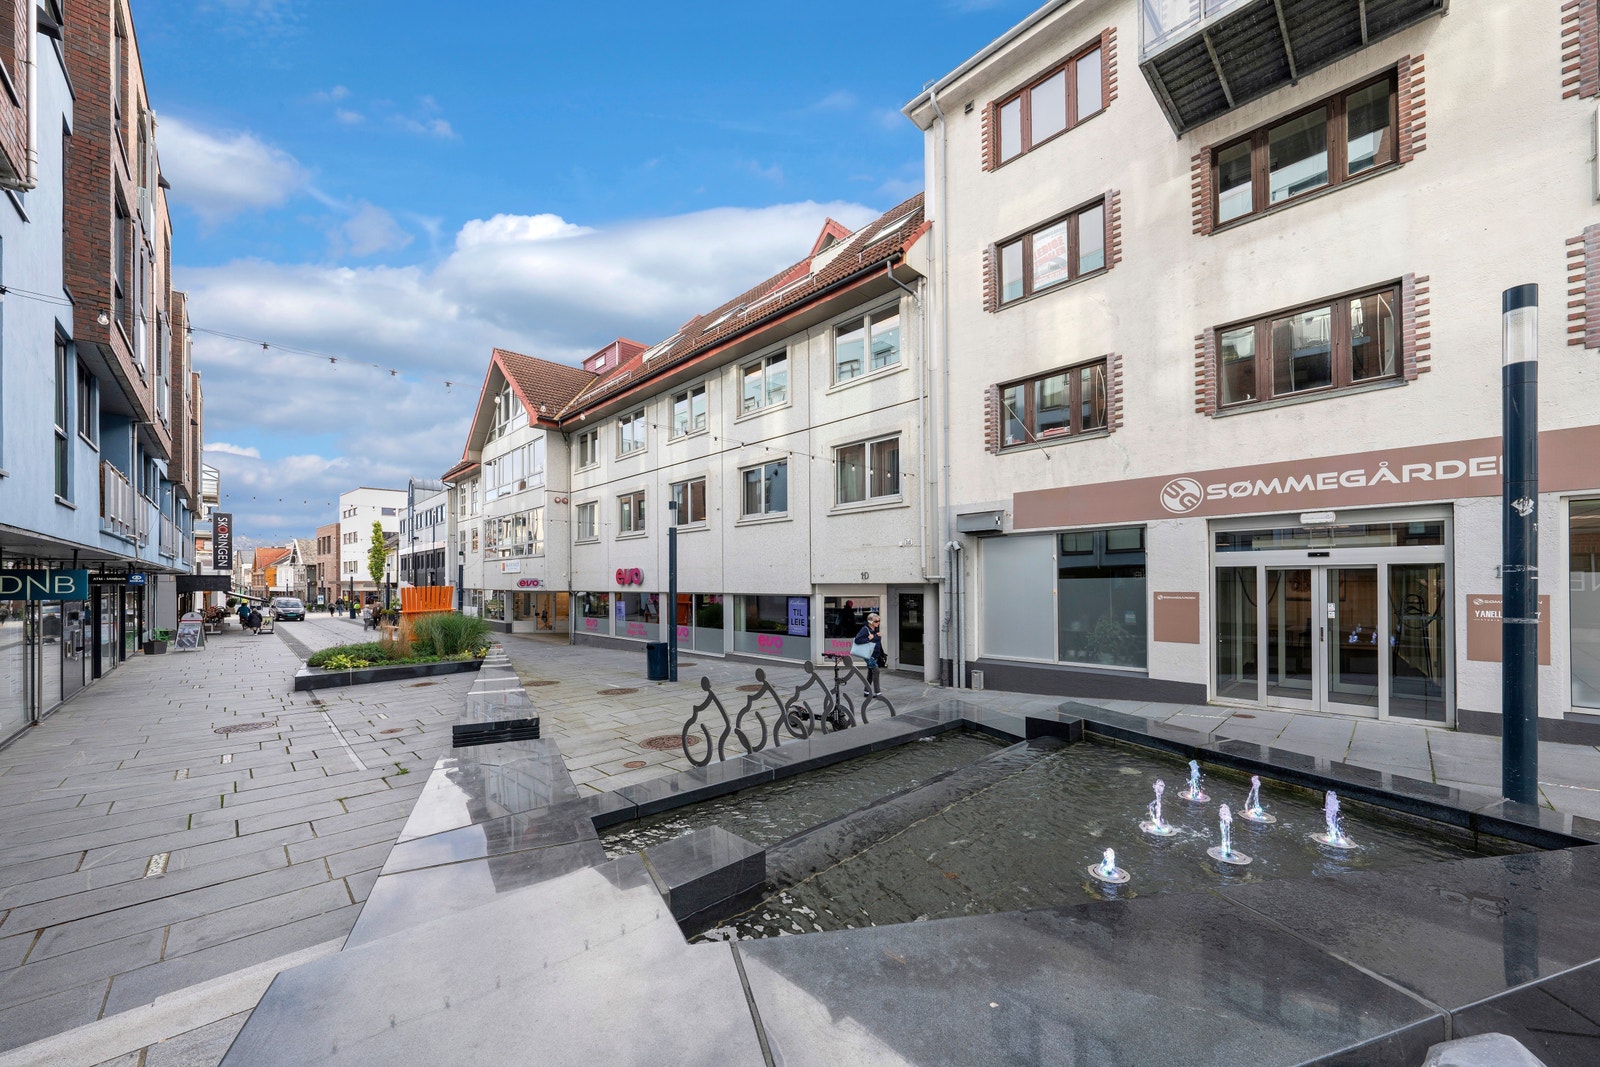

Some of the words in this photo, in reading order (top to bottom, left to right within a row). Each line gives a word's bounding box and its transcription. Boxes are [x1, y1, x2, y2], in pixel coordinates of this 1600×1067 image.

[1206, 456, 1503, 500] SØMMEGÅRDE
[217, 517, 228, 567] SKORINGEN
[519, 579, 539, 587] evo
[615, 568, 641, 585] evo
[0, 569, 75, 600] DNB
[792, 608, 803, 617] TIL
[1475, 610, 1502, 618] YANELL
[790, 618, 805, 626] LEIE
[677, 626, 689, 637] vo
[757, 633, 783, 649] evo
